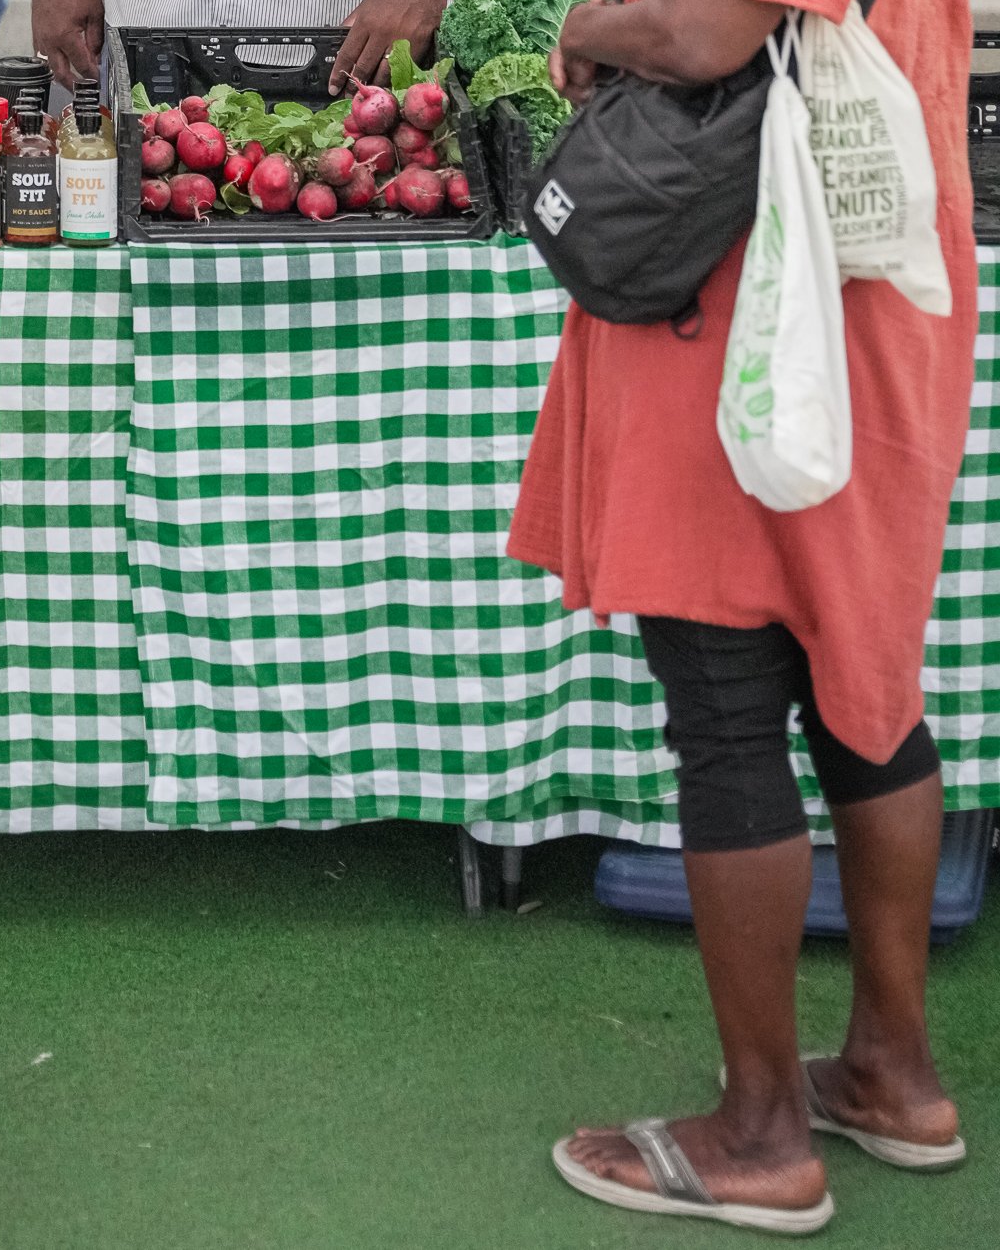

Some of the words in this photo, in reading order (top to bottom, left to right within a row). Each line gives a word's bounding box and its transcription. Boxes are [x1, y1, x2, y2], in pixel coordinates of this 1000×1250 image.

[12, 172, 52, 186] SOUL
[66, 177, 105, 190] SOUL
[838, 166, 903, 189] PEANUTS
[19, 189, 46, 202] FIT
[72, 193, 98, 206] FIT
[825, 188, 893, 219] LNUTS
[12, 208, 27, 216] HOT
[28, 208, 52, 216] SAUCE
